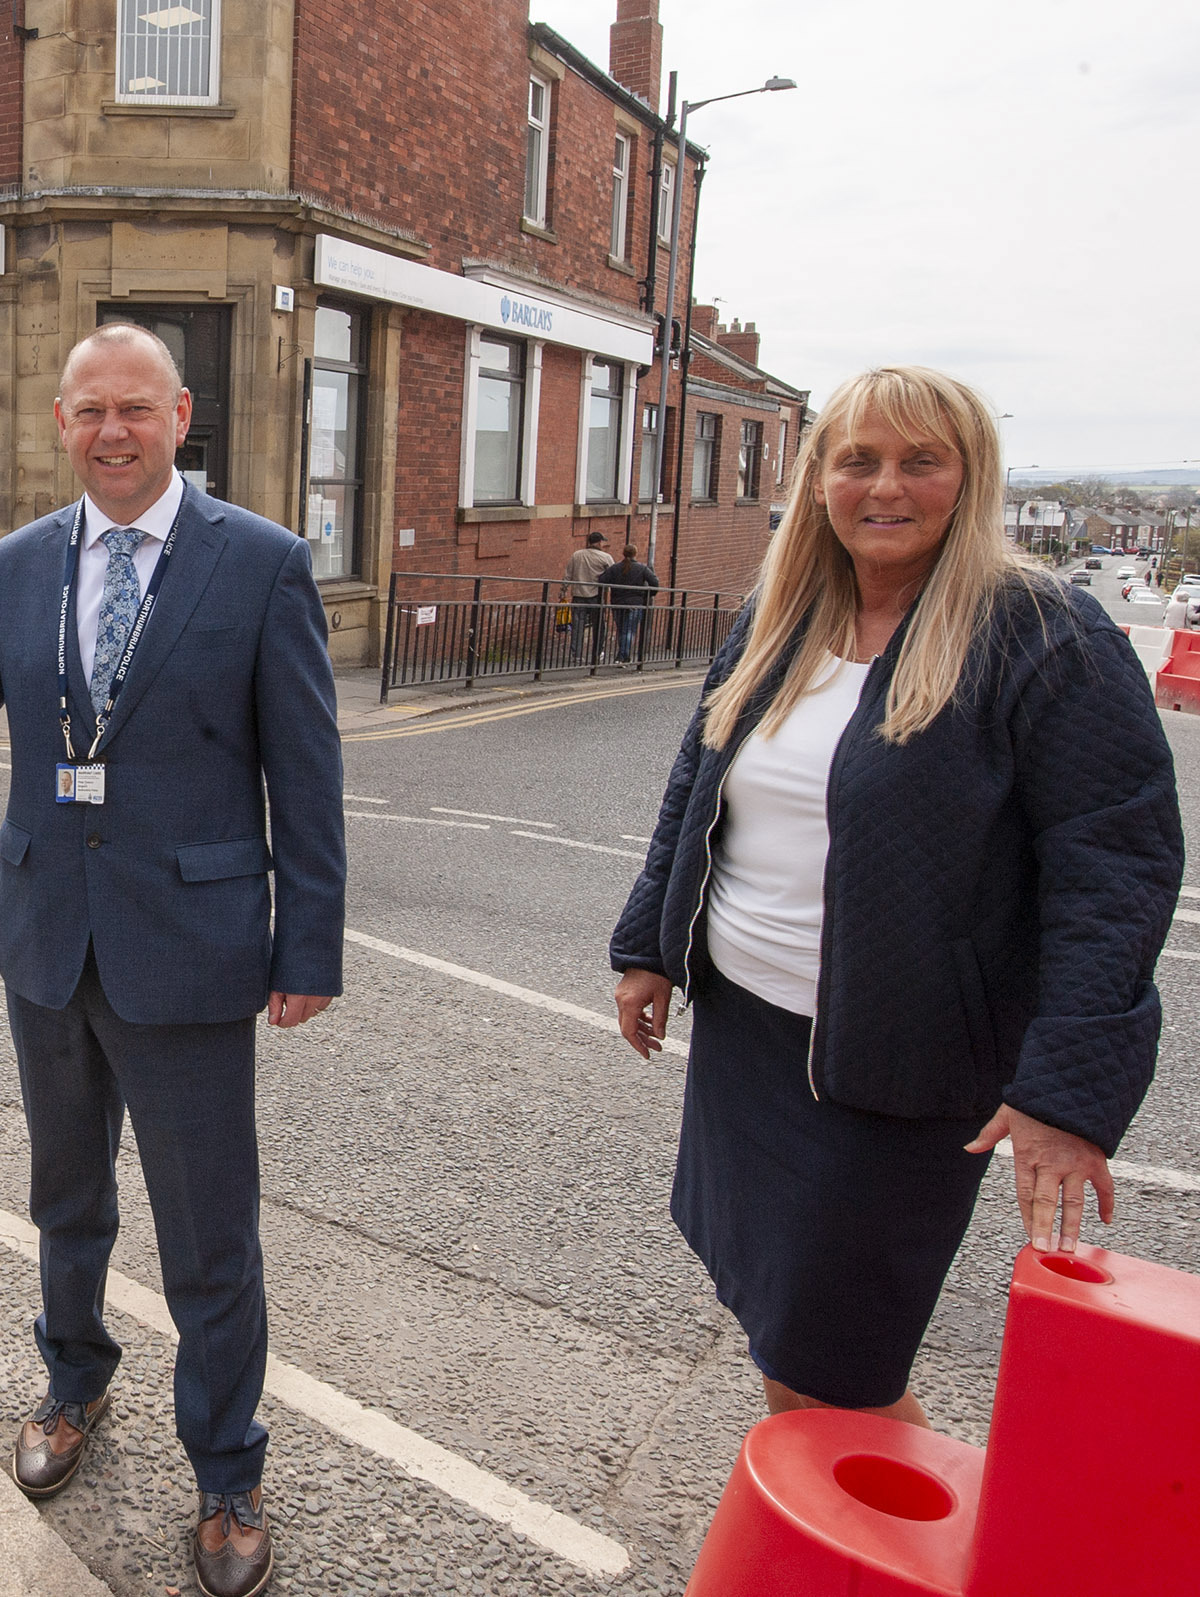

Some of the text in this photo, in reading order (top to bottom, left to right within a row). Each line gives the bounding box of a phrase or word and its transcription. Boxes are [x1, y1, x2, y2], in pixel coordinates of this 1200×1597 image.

[511, 300, 552, 332] BARCLAYS
[58, 584, 70, 675] NORTHUMBRIA POLICE
[115, 593, 154, 682] NORTHUMBRIA POLICE
